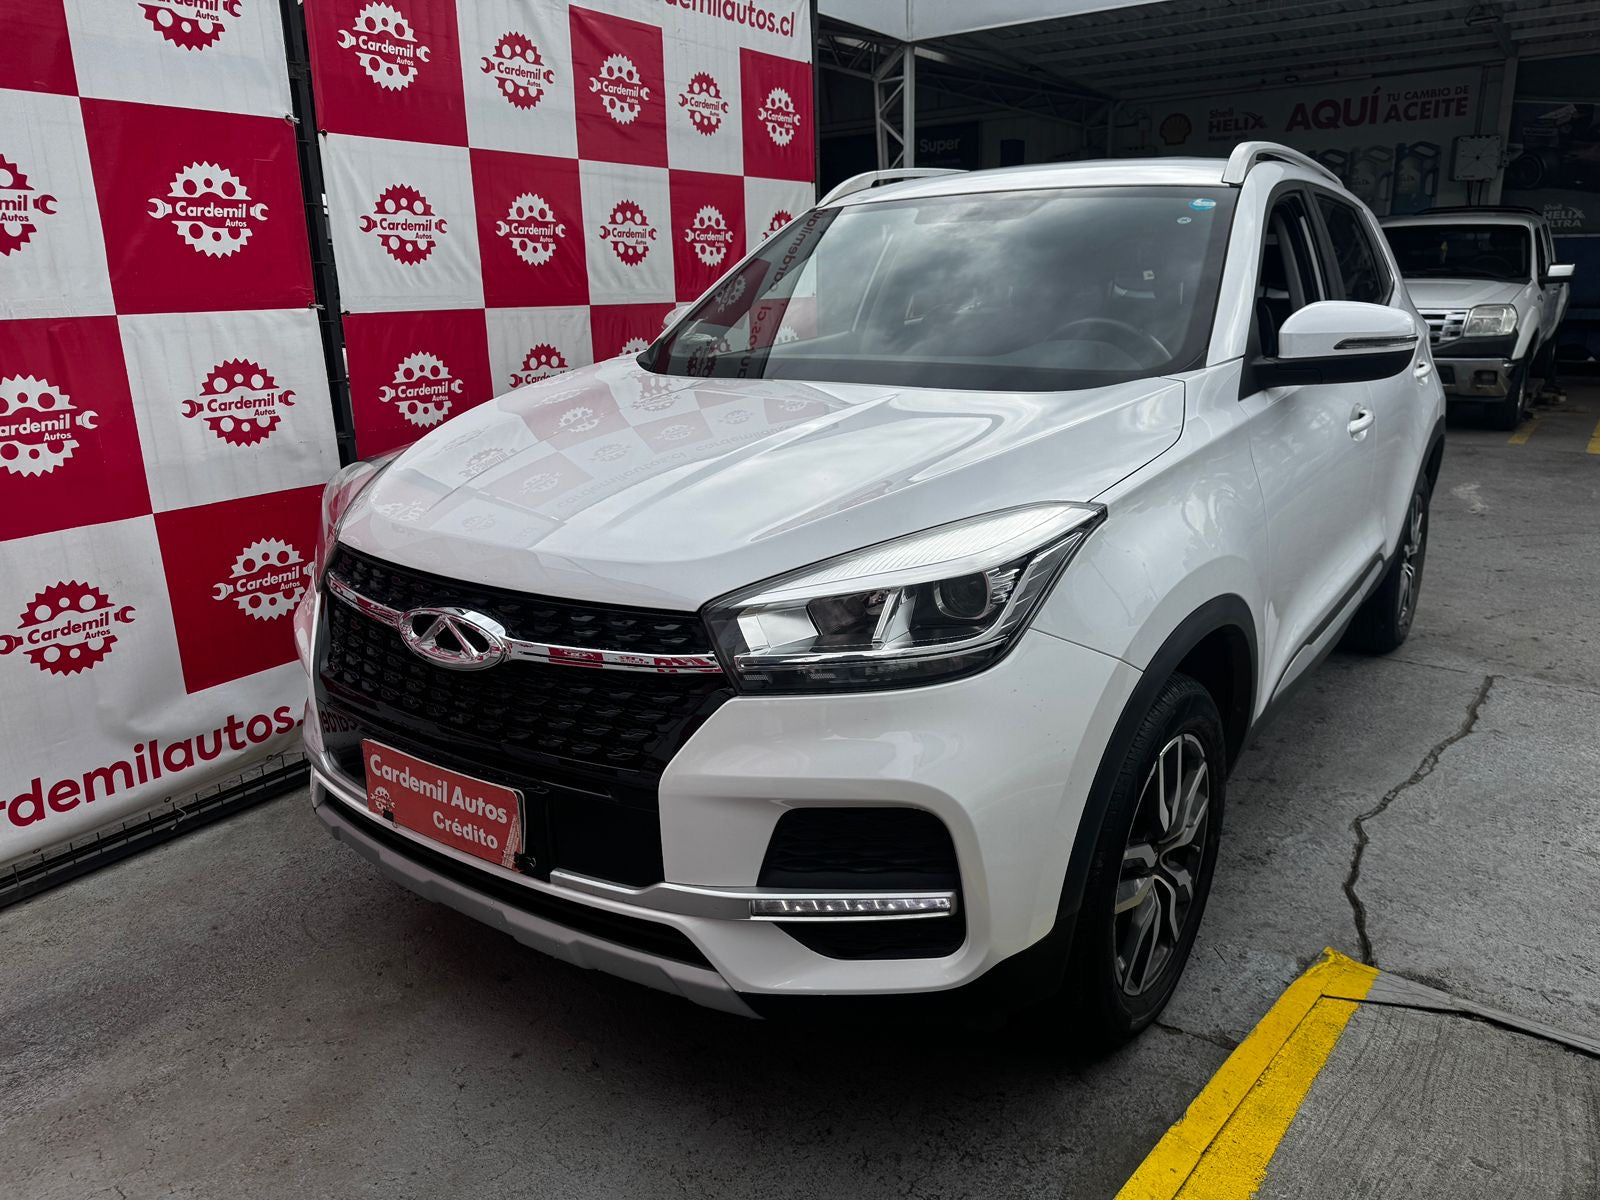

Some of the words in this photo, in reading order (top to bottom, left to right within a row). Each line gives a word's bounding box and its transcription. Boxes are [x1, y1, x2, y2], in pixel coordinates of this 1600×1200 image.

[195, 10, 220, 21] Autos
[358, 35, 415, 58] Cardemil
[396, 57, 415, 66] Autos
[497, 62, 542, 80] Cardemil
[526, 79, 542, 88] Autos
[602, 80, 640, 97] Cardemil
[1386, 93, 1401, 103] TU
[1404, 86, 1452, 102] CAMBIO
[1455, 85, 1471, 95] DE
[689, 97, 720, 111] Cardemil
[1285, 86, 1382, 132] AQUÍ
[1383, 96, 1469, 124] ACEITE
[767, 111, 794, 123] Cardemil
[1209, 107, 1234, 119] Shell
[1208, 112, 1269, 134] HELIX
[919, 138, 961, 155] Super
[0, 212, 30, 222] Autos
[175, 202, 247, 218] Cardemil
[225, 218, 247, 228] Autos
[379, 217, 433, 232] Cardemil
[511, 222, 554, 236] Cardemil
[415, 232, 433, 240] Autos
[611, 228, 647, 240] Cardemil
[695, 231, 725, 243] Cardemil
[398, 383, 449, 398] Cardemil
[207, 393, 275, 413] Cardemil
[432, 394, 449, 402] Autos
[254, 408, 277, 417] Autos
[43, 433, 72, 442] Autos
[236, 565, 300, 592] Cardemil
[280, 581, 301, 591] Autos
[27, 612, 110, 645] Cardemil
[84, 628, 112, 641] Autos
[369, 754, 448, 804] Cardemil
[450, 786, 508, 824] Autos
[432, 811, 499, 849] Crédito
